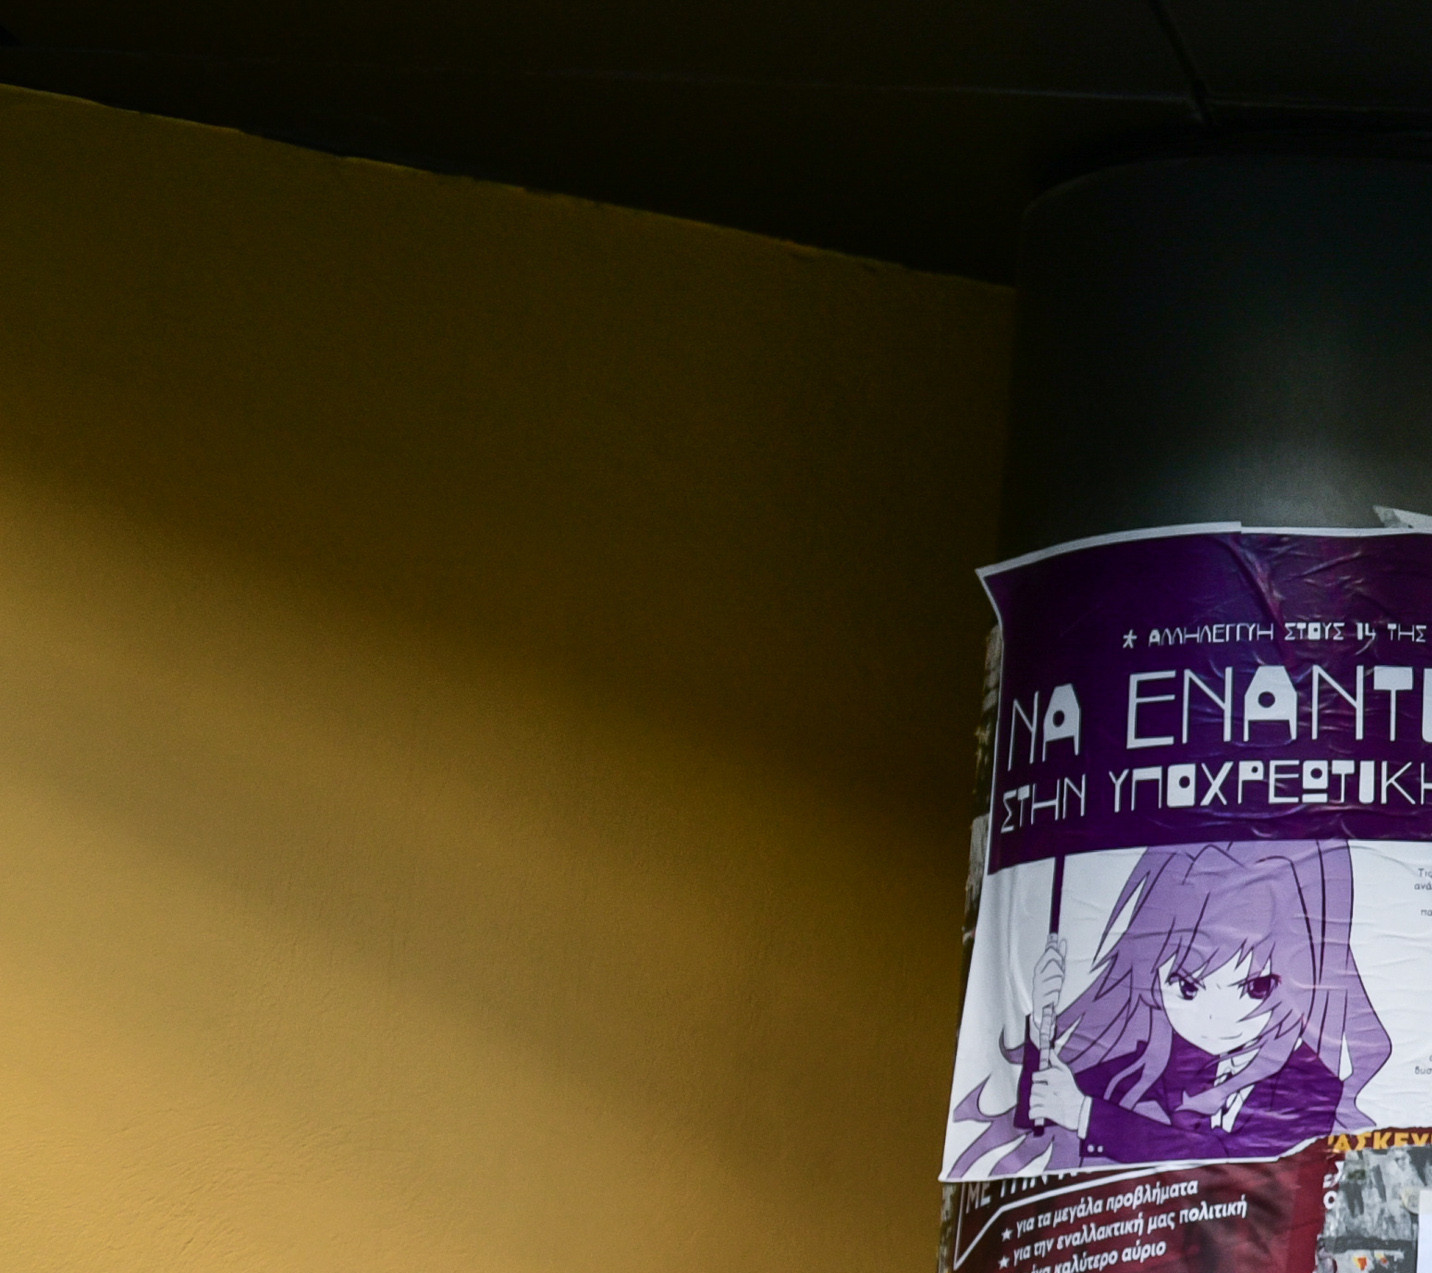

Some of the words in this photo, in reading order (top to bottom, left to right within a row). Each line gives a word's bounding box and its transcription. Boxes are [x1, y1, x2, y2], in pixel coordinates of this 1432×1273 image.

[1284, 622, 1345, 641] ΣΤΟΥΣ
[1355, 623, 1376, 641] 14
[1387, 624, 1427, 643] ΤΗΣ
[1008, 683, 1081, 771] ΝΑ
[1000, 773, 1086, 834] ΣΤΗΝ
[1013, 1245, 1030, 1267] για
[1034, 1237, 1054, 1258] την
[1057, 1215, 1143, 1250] εναλλακτική
[1148, 1210, 1175, 1235] μας
[1179, 1194, 1248, 1225] πολιτική
[1016, 1218, 1034, 1238] για
[1037, 1214, 1051, 1228] τα
[1053, 1195, 1103, 1228] μεγάλα
[1106, 1179, 1198, 1213] προβλήματα
[1122, 1239, 1166, 1263] αύριο
